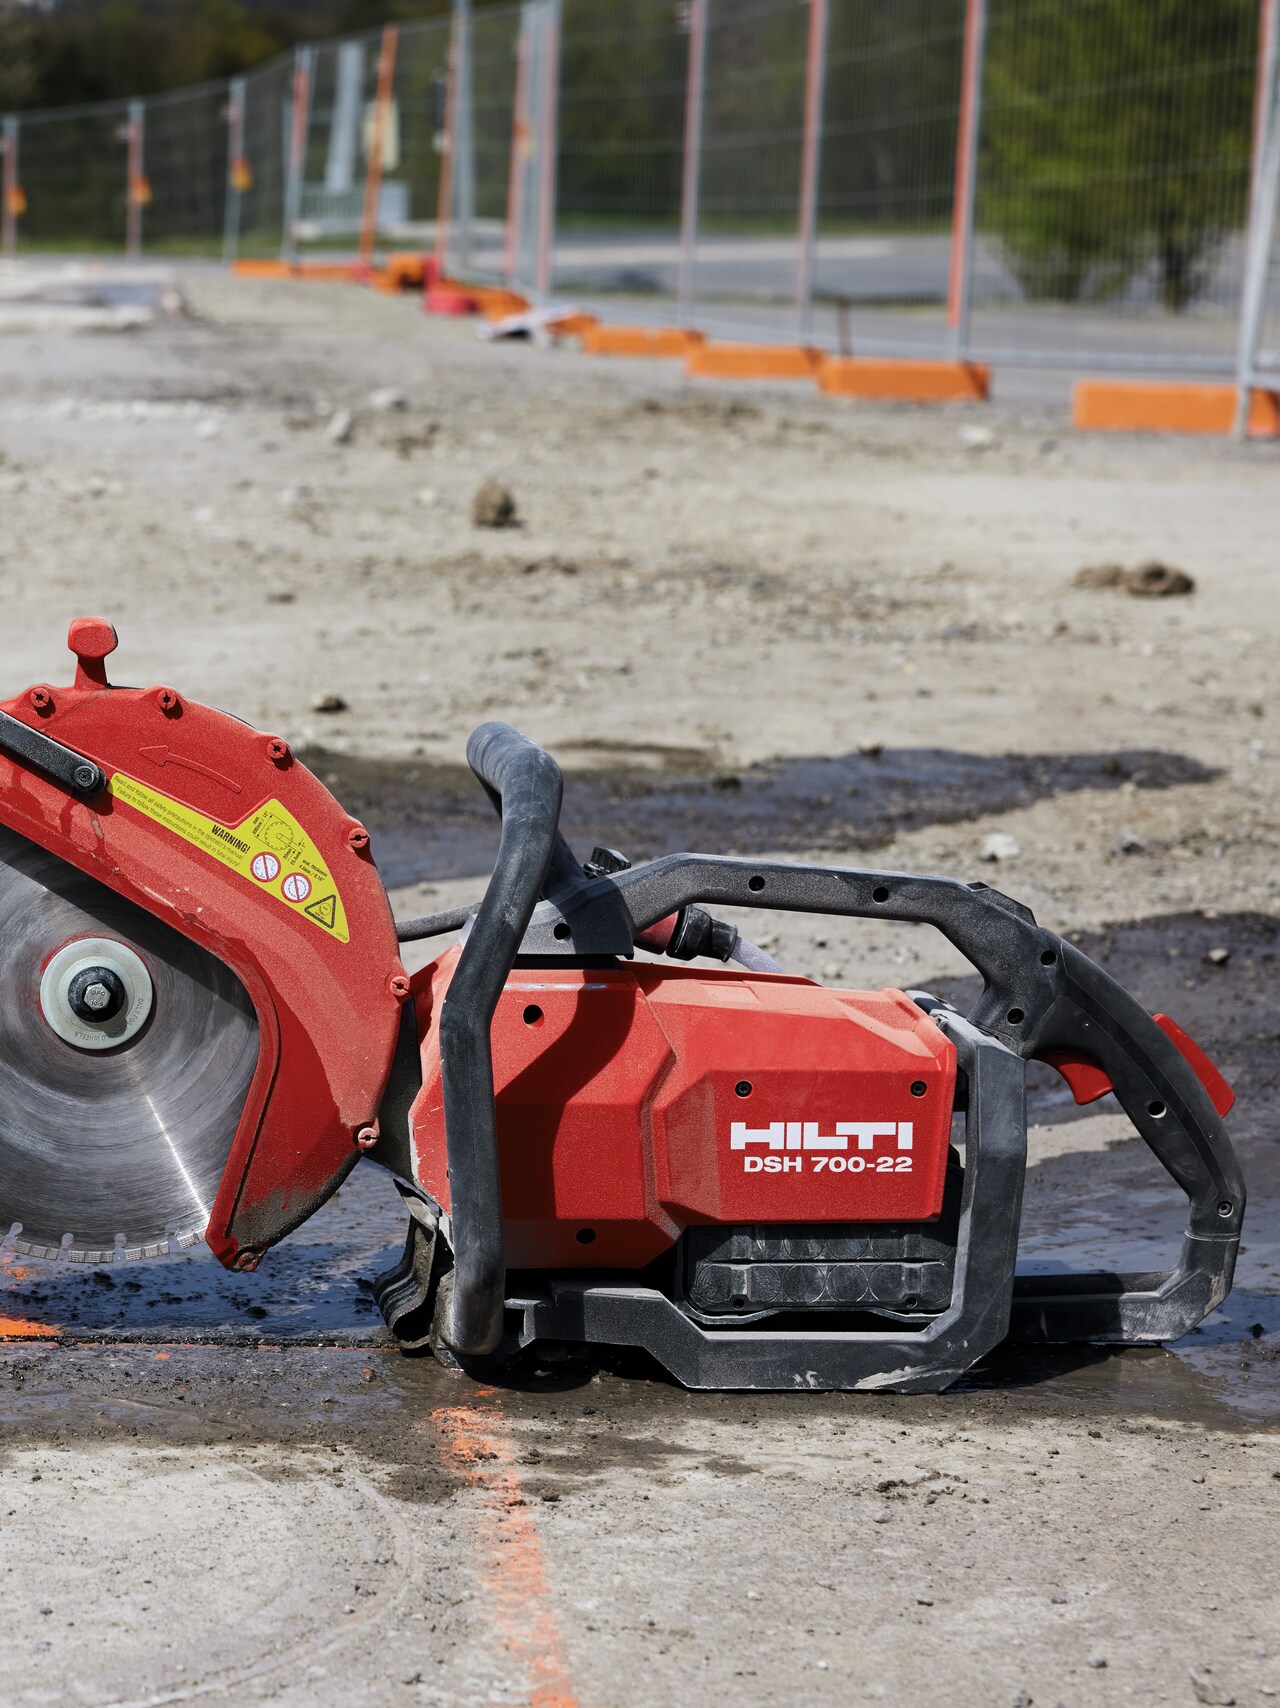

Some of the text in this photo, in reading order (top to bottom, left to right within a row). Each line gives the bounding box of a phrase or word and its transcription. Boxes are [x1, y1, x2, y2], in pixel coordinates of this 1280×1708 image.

[114, 776, 127, 787] Read
[126, 784, 136, 792] and
[135, 788, 148, 800] follow
[154, 801, 167, 813] safety
[167, 810, 193, 829] precautions
[197, 828, 205, 836] the
[116, 787, 132, 799] Failure
[137, 799, 150, 811] follow
[149, 807, 162, 819] these
[162, 816, 187, 835] instructions
[186, 831, 200, 842] could
[200, 838, 212, 849] result
[217, 849, 226, 860] fatal
[211, 824, 251, 854] WARNING!
[730, 1121, 913, 1150] HILTI
[743, 1156, 913, 1173] DSH 700-22
